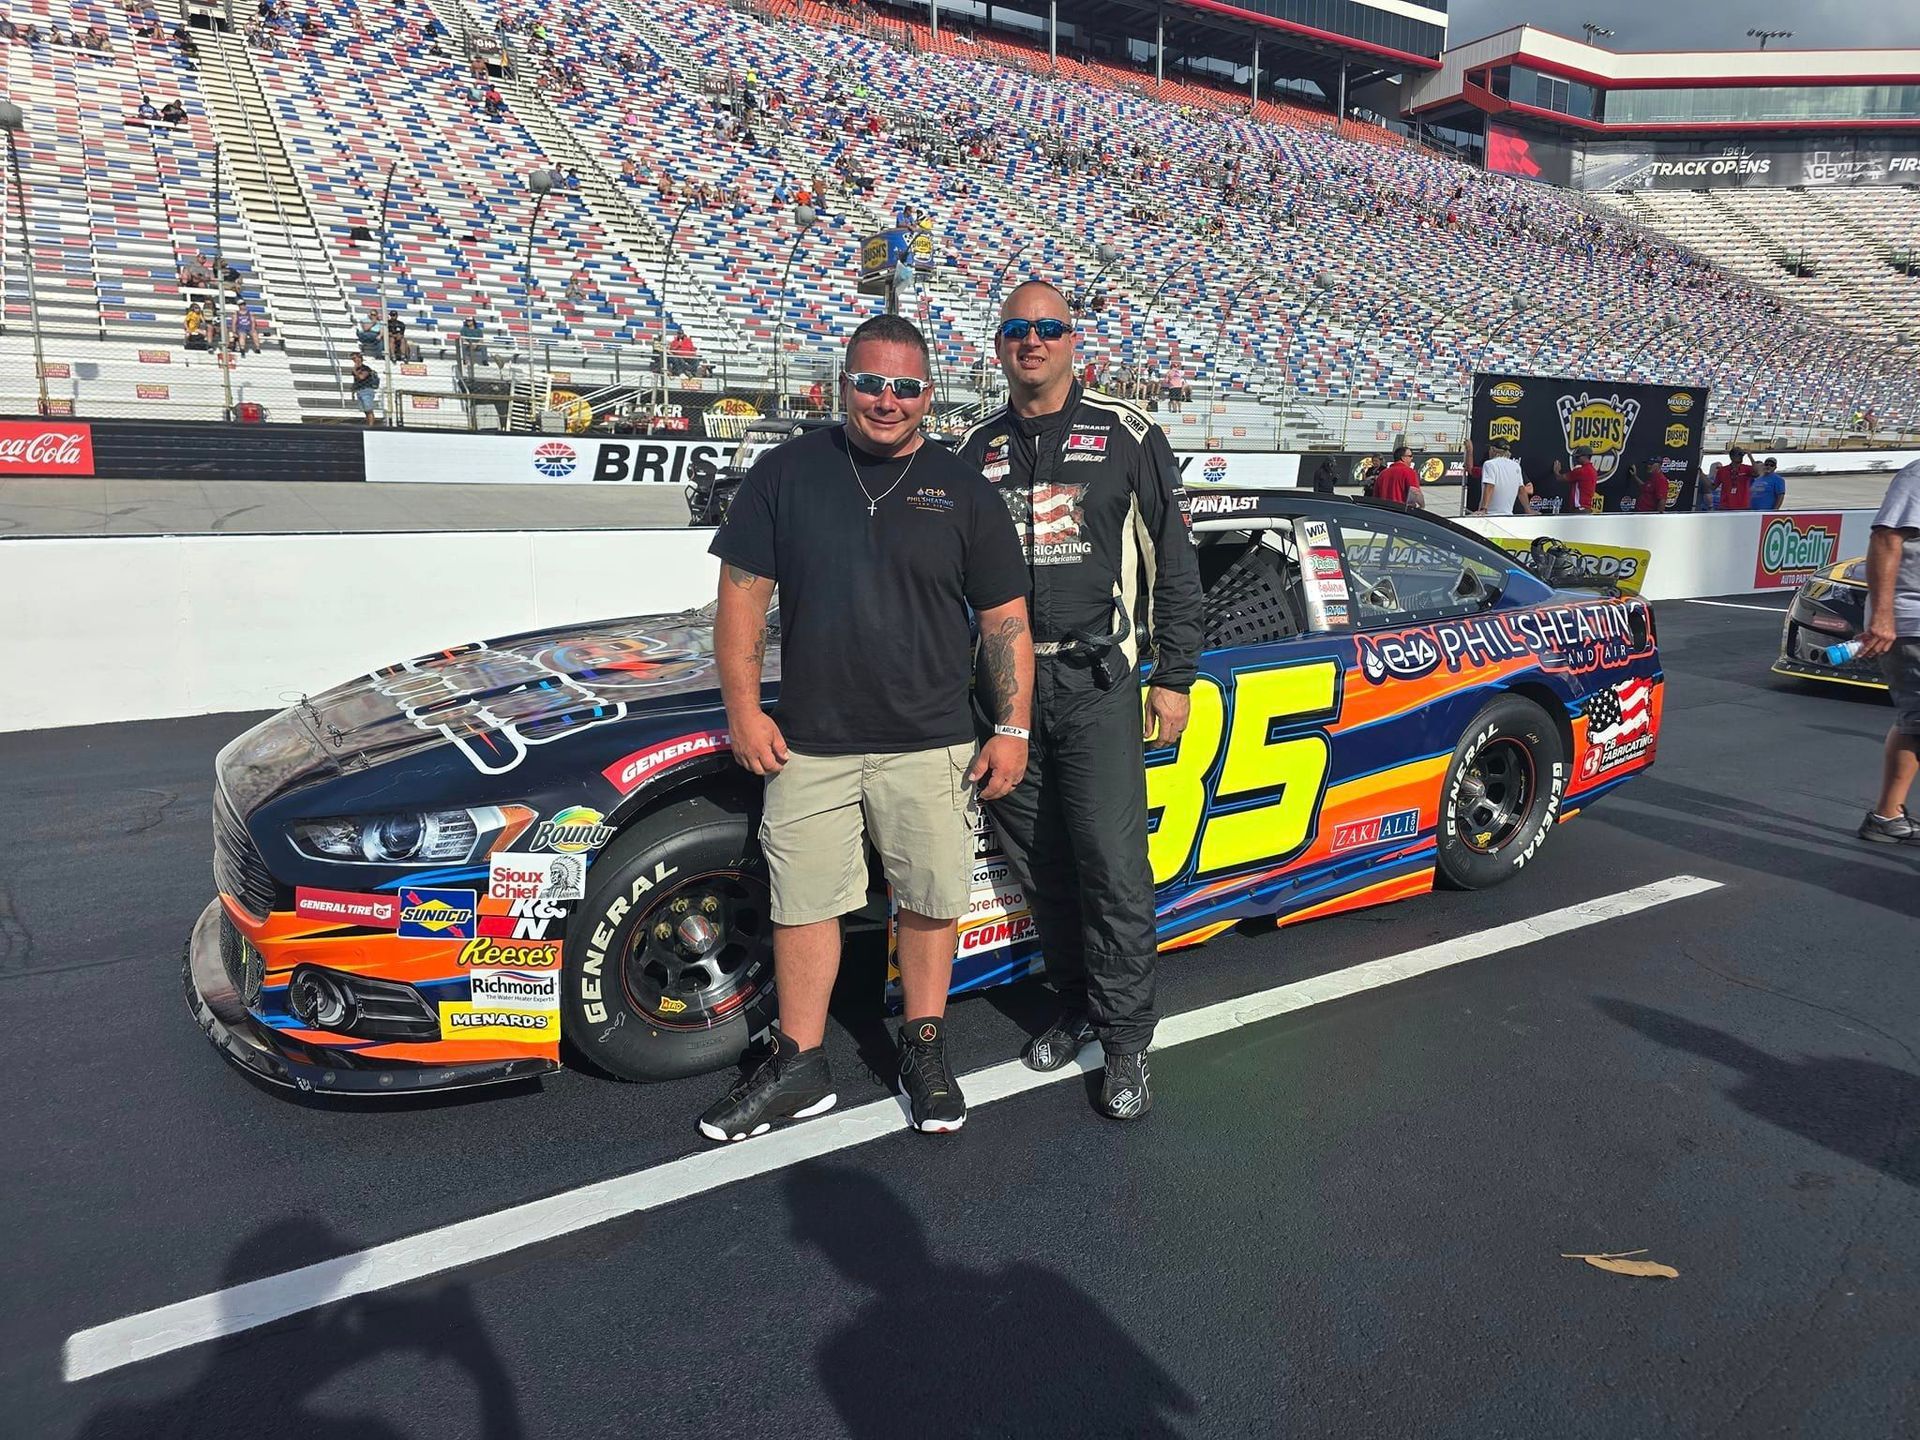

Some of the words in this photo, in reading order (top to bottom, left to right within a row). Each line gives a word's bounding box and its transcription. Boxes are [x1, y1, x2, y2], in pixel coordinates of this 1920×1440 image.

[1722, 146, 1746, 157] 1961
[1651, 161, 1707, 176] TRACK
[1711, 159, 1771, 175] OPENS
[1888, 157, 1920, 171] FIR
[1490, 389, 1524, 398] MENARDS
[656, 419, 684, 430] AVs
[1125, 415, 1145, 432] OMP
[1491, 423, 1519, 437] BUSH'S
[1574, 417, 1621, 443] BUSH'S
[1667, 430, 1688, 441] BUSH'S
[1590, 441, 1603, 449] BEST
[1306, 524, 1327, 538] WIX
[1764, 525, 1832, 571] O'Reilly
[1781, 574, 1795, 584] AUTO
[1568, 650, 1594, 665] AND
[1605, 645, 1626, 659] AIR
[1002, 725, 1017, 735] ARCA
[1602, 734, 1653, 764] FABRICATING
[1605, 740, 1617, 751] CB
[621, 737, 711, 784] GENERAL
[1447, 723, 1499, 836] GENERAL
[1512, 762, 1563, 868] GENERAL
[530, 821, 615, 852] Bounty
[1336, 823, 1378, 846] ZAKI
[1382, 815, 1410, 837] ALI
[492, 867, 544, 883] Sioux
[491, 883, 538, 899] Chief
[300, 899, 346, 913] GENERAL
[347, 905, 373, 916] TIRE
[402, 908, 470, 922] SUNOCO
[963, 916, 1032, 950] COMP
[581, 860, 679, 1024] GENERAL
[458, 937, 558, 967] Reese's
[473, 976, 555, 995] Richmond
[662, 1000, 682, 1010] AERO
[451, 1013, 548, 1029] MENARDS
[1038, 1044, 1049, 1066] OMP
[1112, 1090, 1134, 1109] OMP
